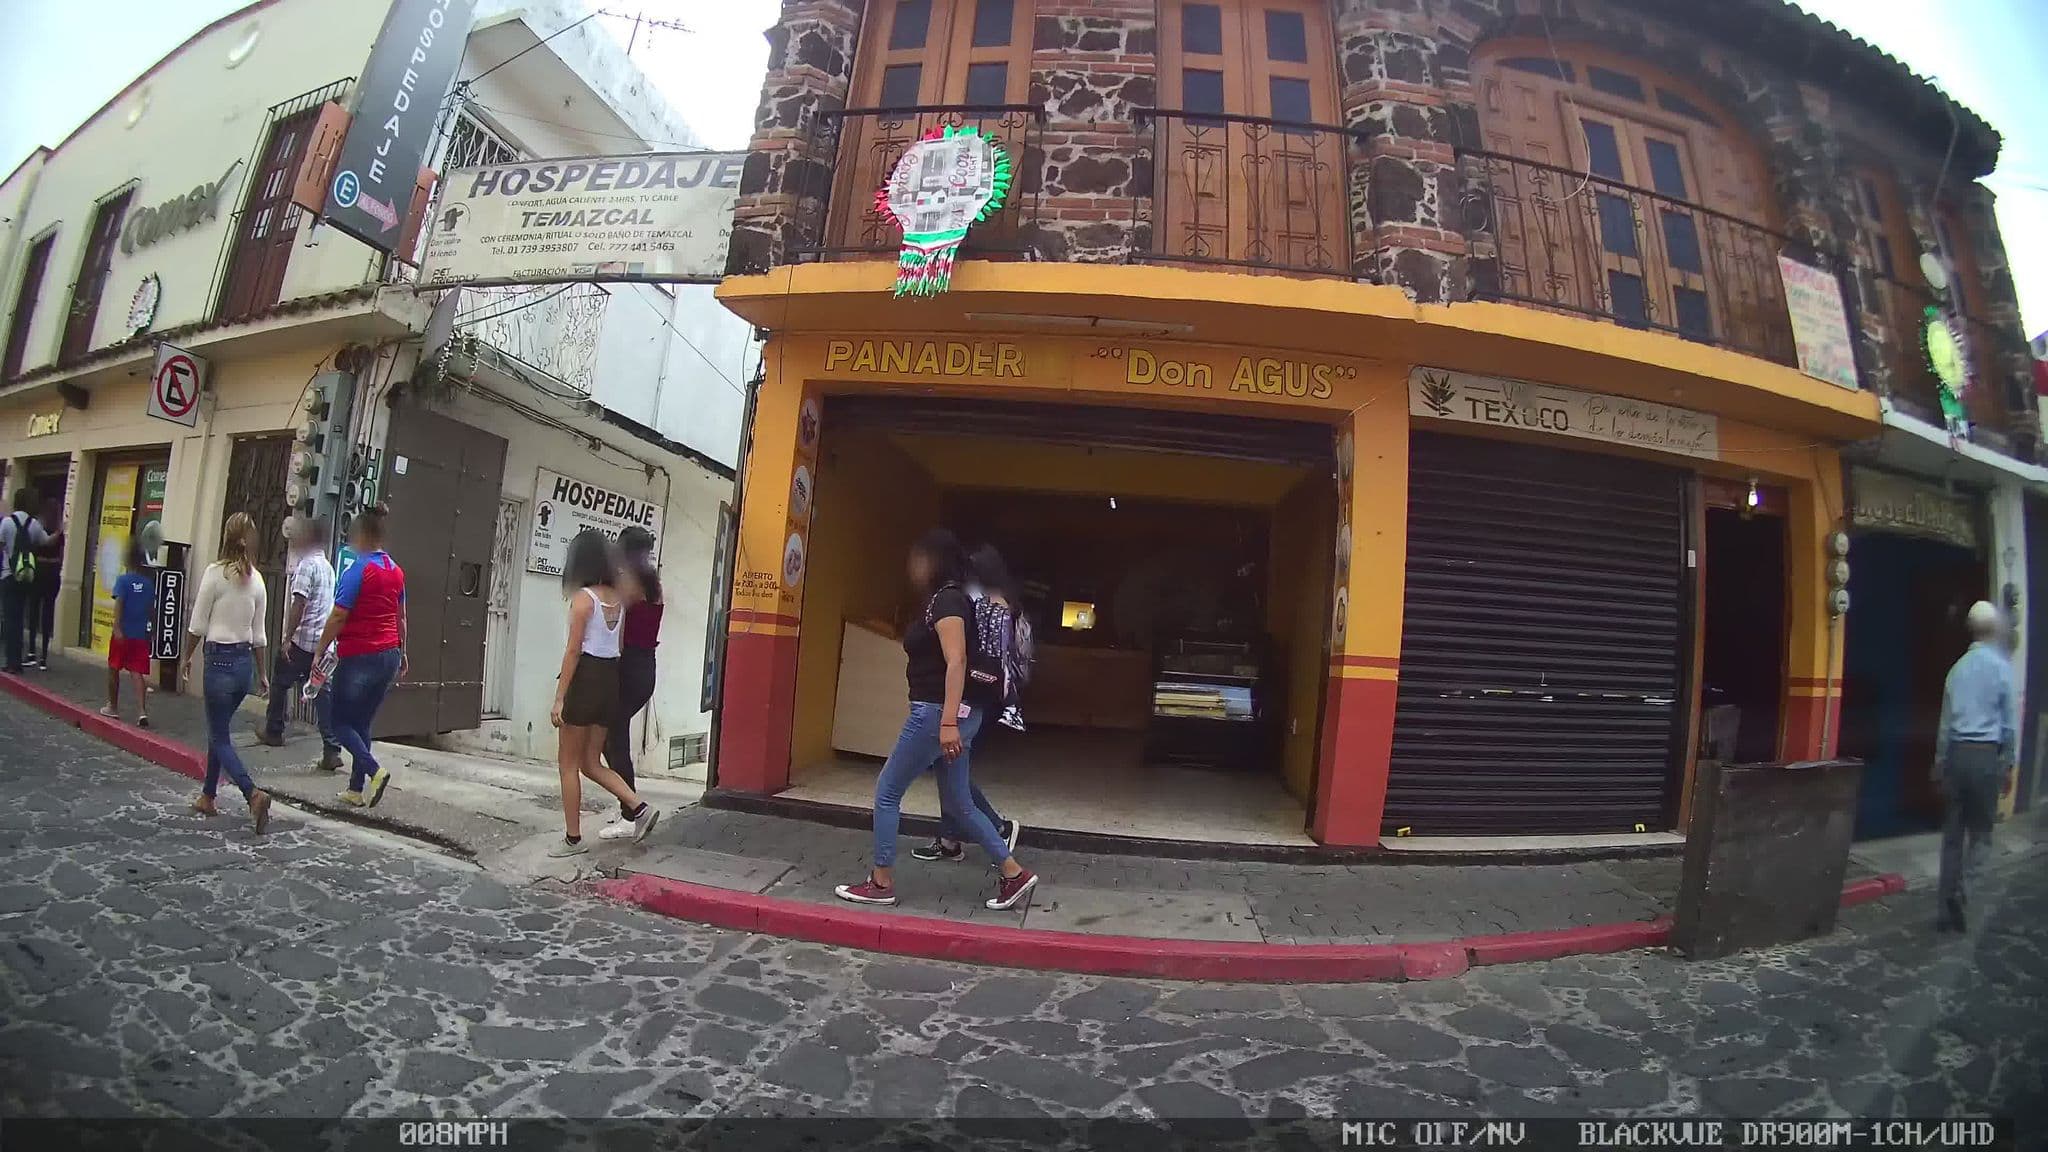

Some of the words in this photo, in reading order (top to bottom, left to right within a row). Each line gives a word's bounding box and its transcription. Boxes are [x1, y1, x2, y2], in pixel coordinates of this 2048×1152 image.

[369, 0, 449, 184] OSPEDAJE
[468, 159, 744, 198] HOSPEDAJE
[521, 208, 655, 228] TEMAZCAL
[552, 477, 655, 527] HOSPEDAJE
[162, 575, 178, 656] BASURA
